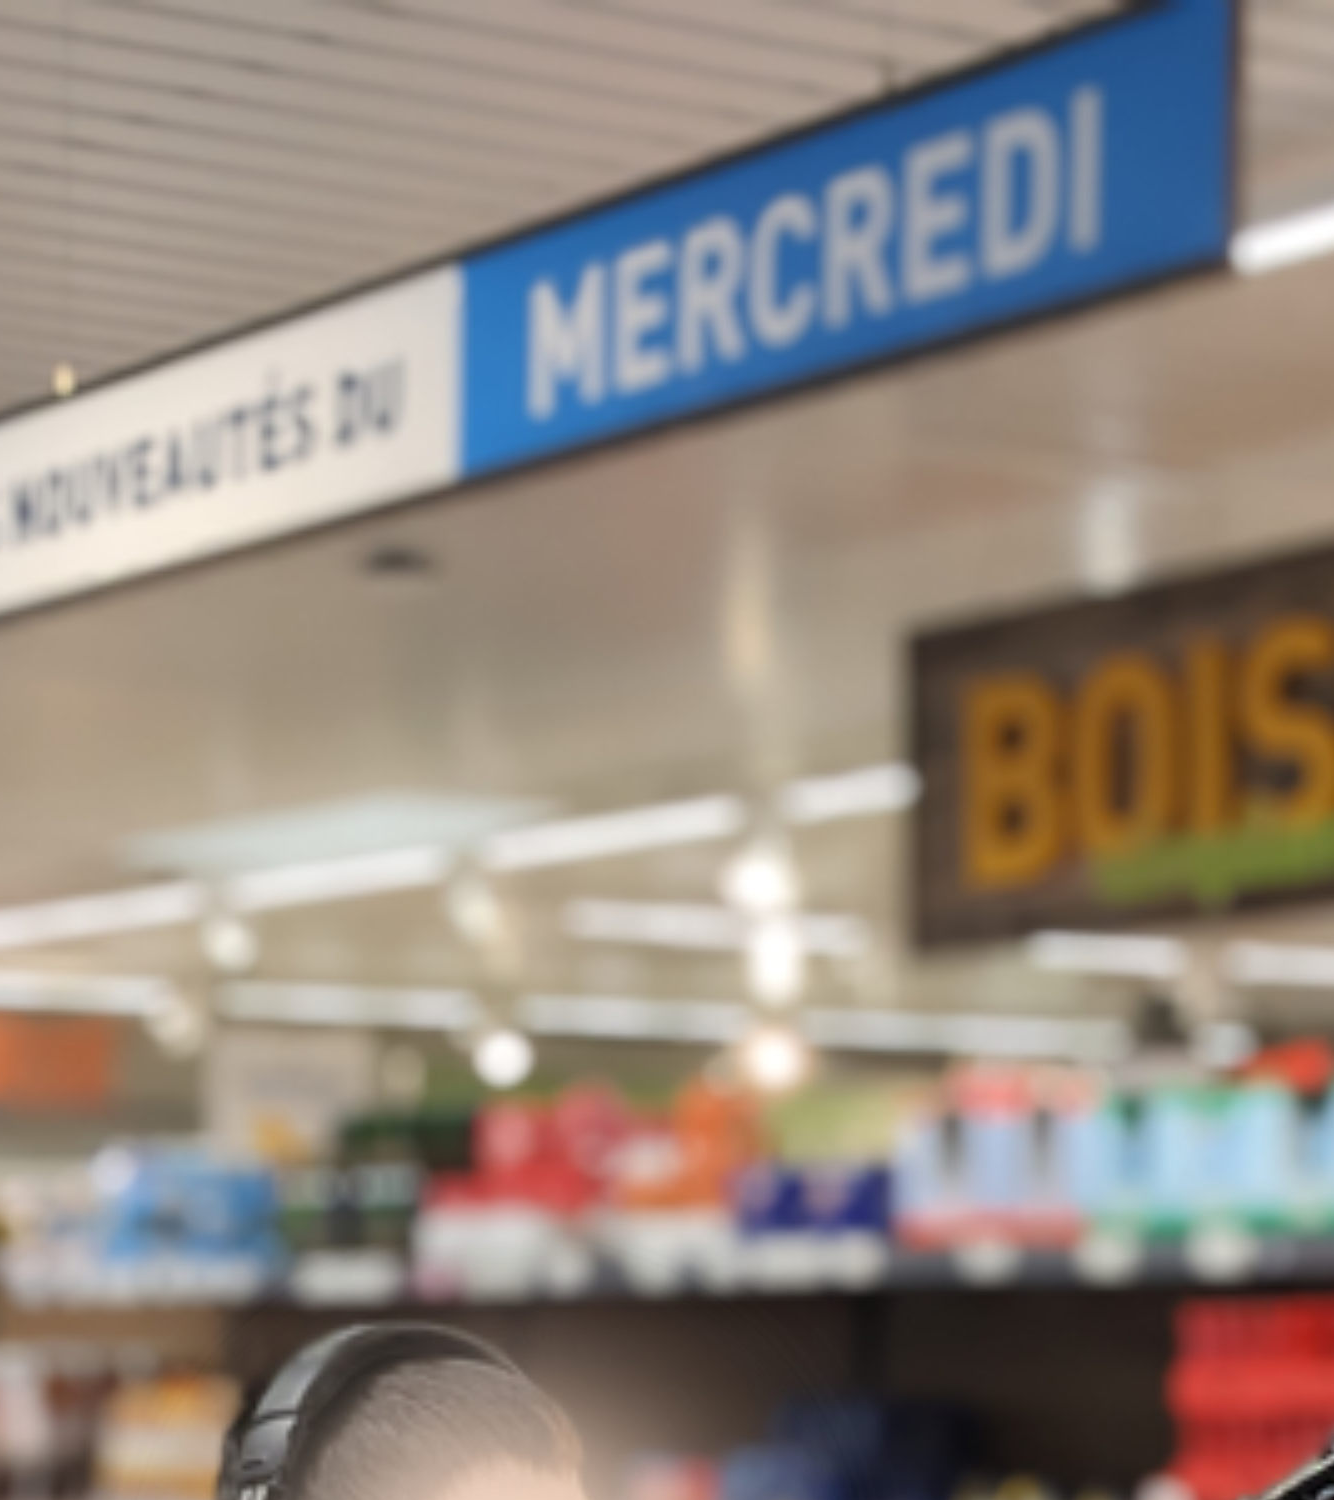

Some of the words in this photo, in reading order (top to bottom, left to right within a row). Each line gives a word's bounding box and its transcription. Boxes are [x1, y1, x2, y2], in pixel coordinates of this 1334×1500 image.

[10, 366, 317, 546] NOUVEAUTÉS
[333, 352, 409, 451] DU
[523, 84, 1106, 424] MERCREDI
